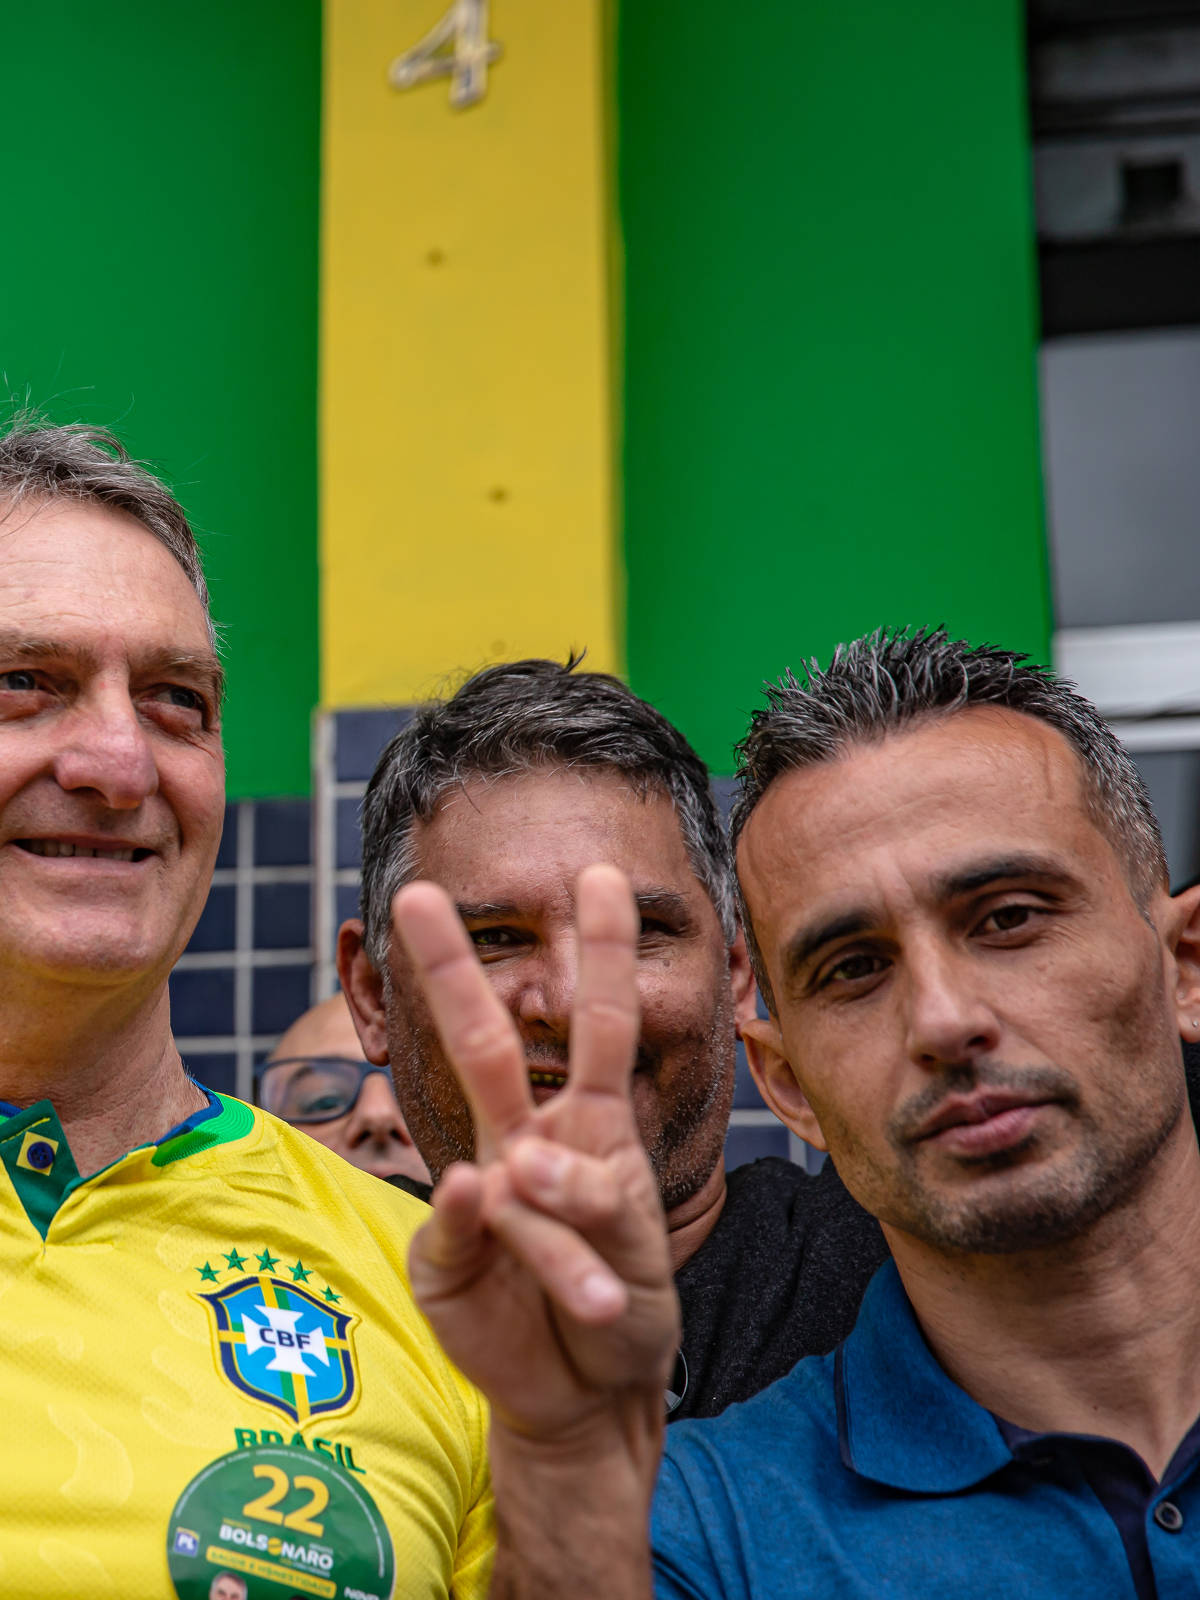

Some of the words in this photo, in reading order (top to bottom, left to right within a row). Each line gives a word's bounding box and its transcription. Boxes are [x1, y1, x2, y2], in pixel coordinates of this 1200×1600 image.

[388, 0, 504, 111] 4
[259, 1327, 311, 1349] CBF
[242, 1464, 329, 1538] 22
[219, 1524, 334, 1570] BOLSONARO
